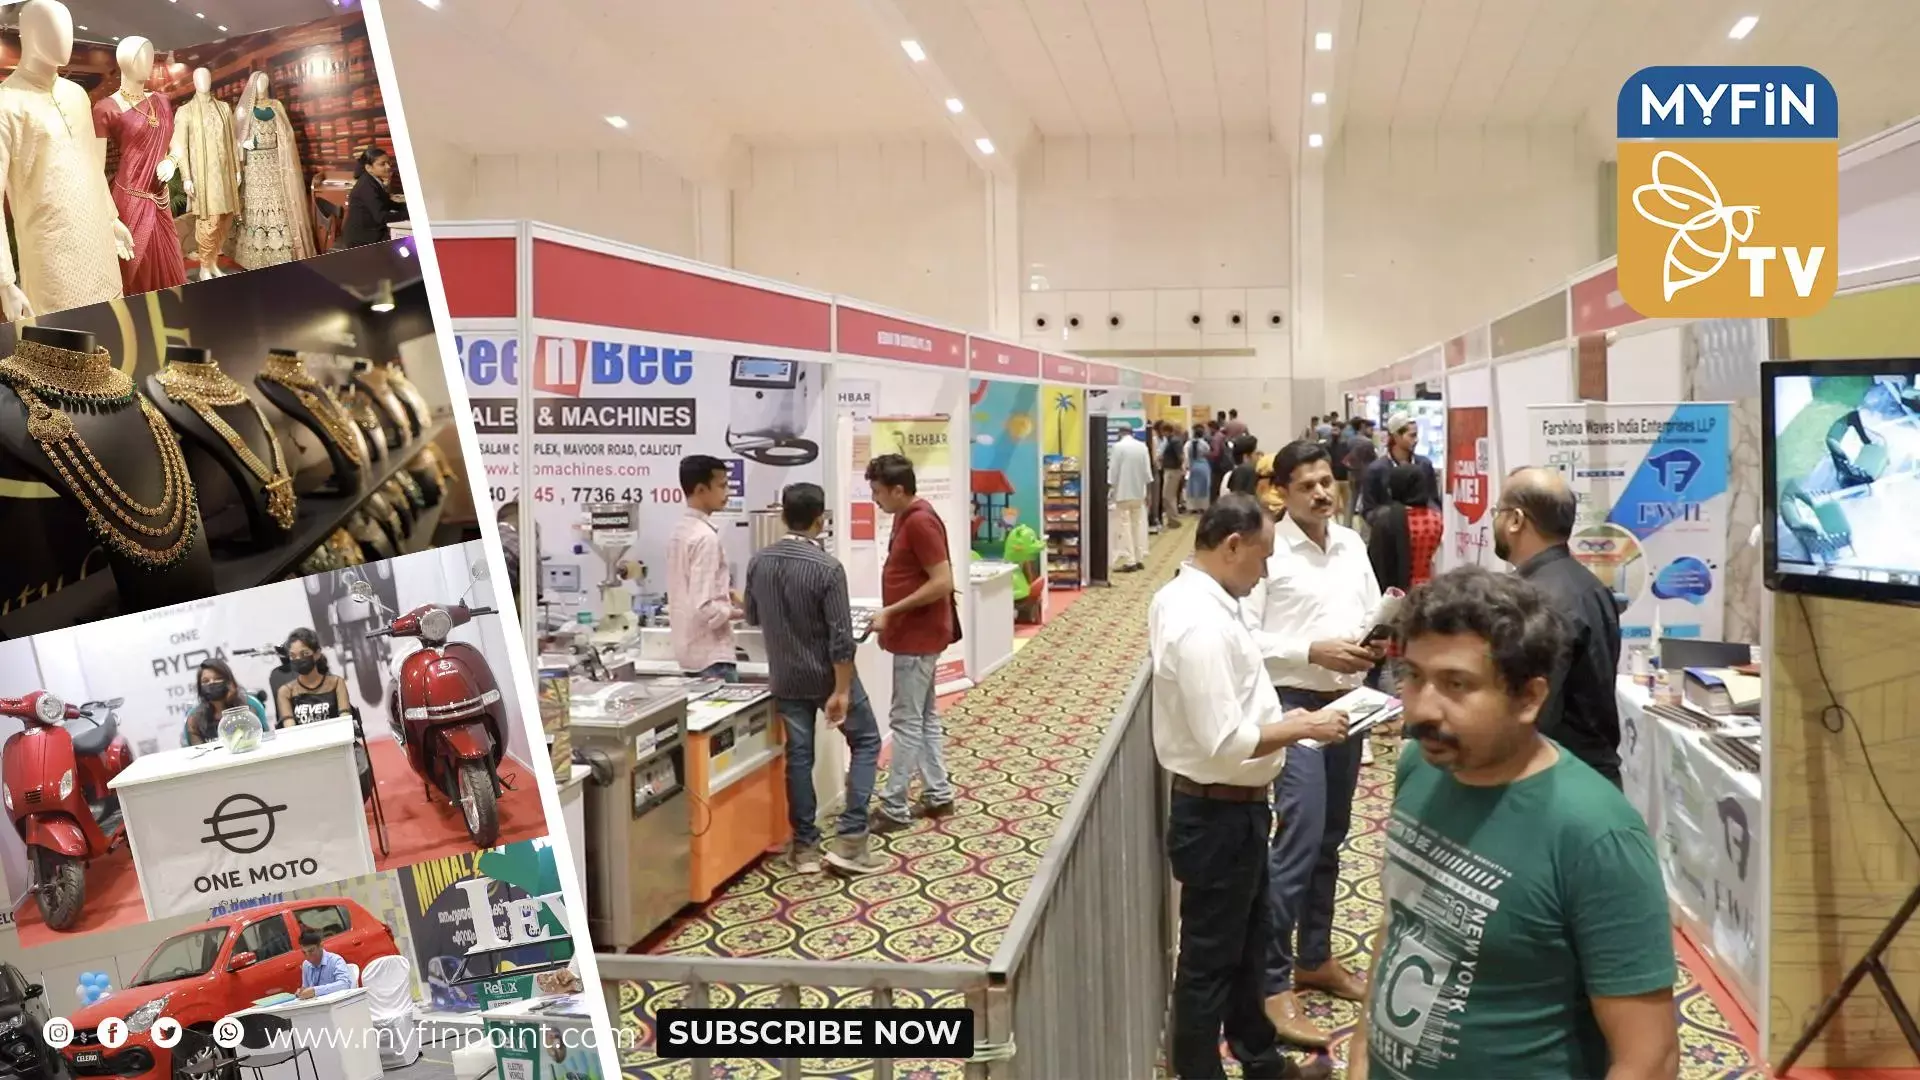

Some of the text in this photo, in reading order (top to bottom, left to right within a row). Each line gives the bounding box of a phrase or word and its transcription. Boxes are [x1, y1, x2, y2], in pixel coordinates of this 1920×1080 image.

[537, 406, 554, 427] &
[561, 406, 692, 428] MACHINES
[1542, 417, 1717, 436] Farshina Waves India Enterprises LLP
[908, 433, 948, 446] REHBAR
[563, 443, 605, 456] MAVOOR
[607, 444, 638, 457] ROAD,
[639, 444, 683, 456] CALICUT
[571, 486, 615, 503] 7736
[621, 487, 644, 503] 43
[650, 487, 684, 504] 100
[169, 629, 200, 645] ONE
[294, 702, 330, 715] NEVER
[194, 857, 318, 893] ONE MOTO
[411, 853, 472, 917] MINNAL
[1466, 907, 1489, 954] NEW
[1450, 960, 1478, 1013] YORK
